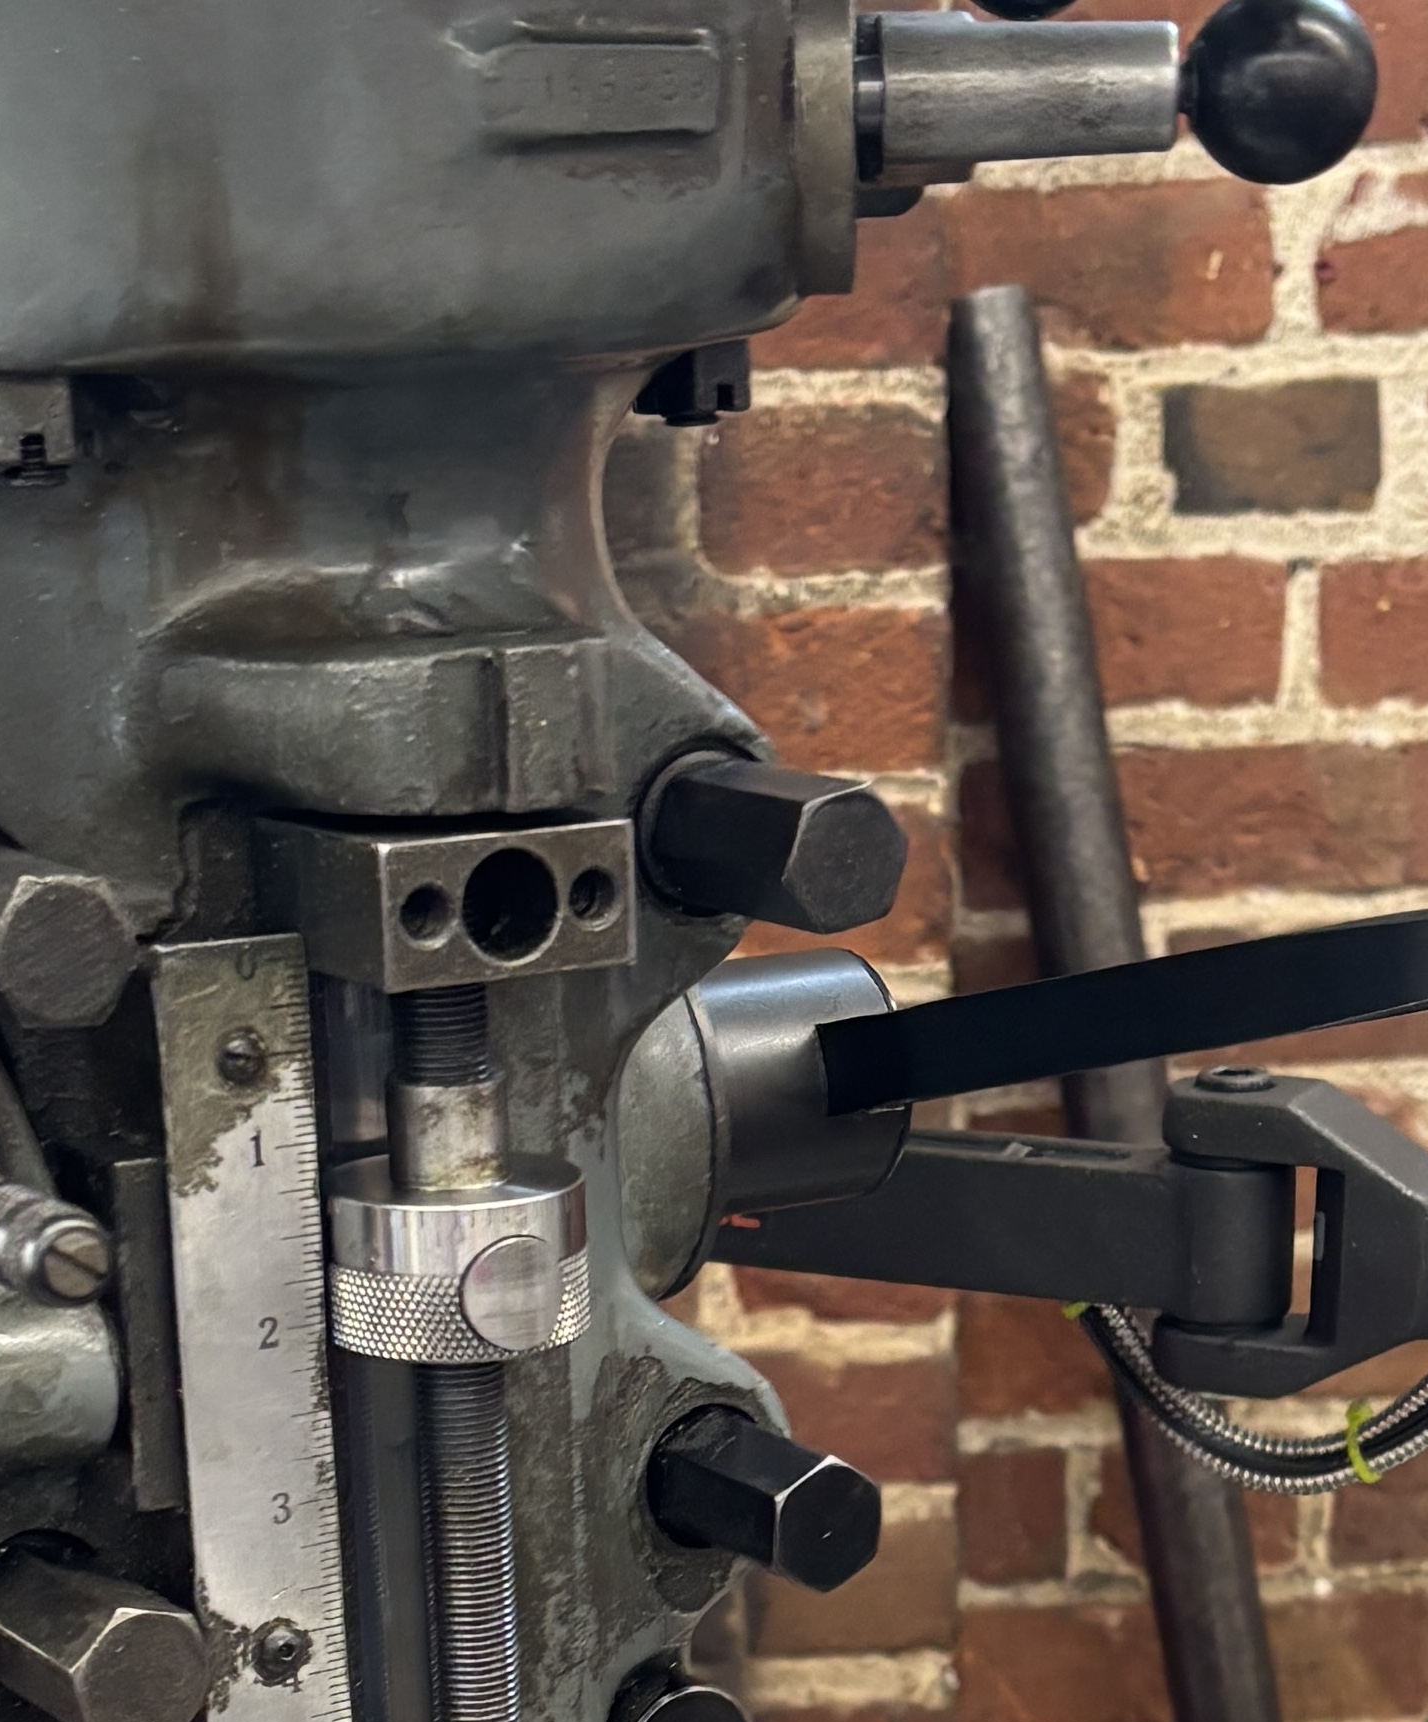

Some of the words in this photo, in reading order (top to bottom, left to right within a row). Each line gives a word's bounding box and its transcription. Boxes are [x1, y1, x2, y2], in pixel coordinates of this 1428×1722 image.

[248, 1129, 266, 1168] 1
[258, 1315, 280, 1351] 2
[272, 1491, 293, 1525] 3
